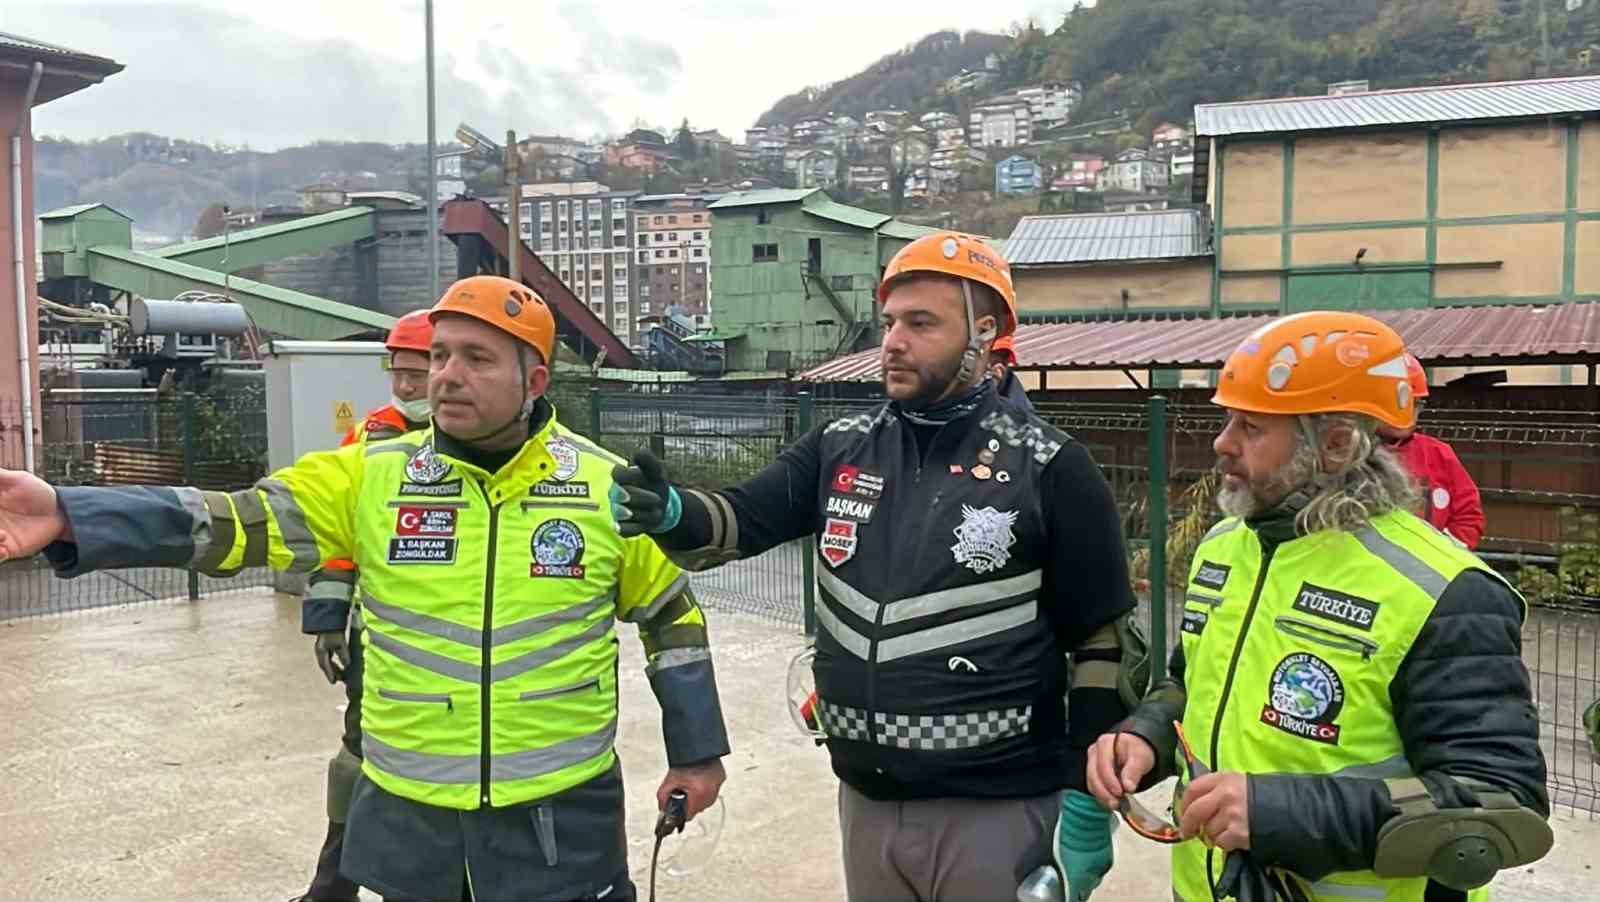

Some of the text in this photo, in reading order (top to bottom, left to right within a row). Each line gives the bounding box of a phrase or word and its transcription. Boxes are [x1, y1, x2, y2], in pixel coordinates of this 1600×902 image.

[826, 497, 873, 518] BAŞKAN
[965, 558, 994, 572] 2024
[1299, 591, 1372, 625] TÜRKİYE
[1279, 714, 1319, 737] TÜRKİYE
